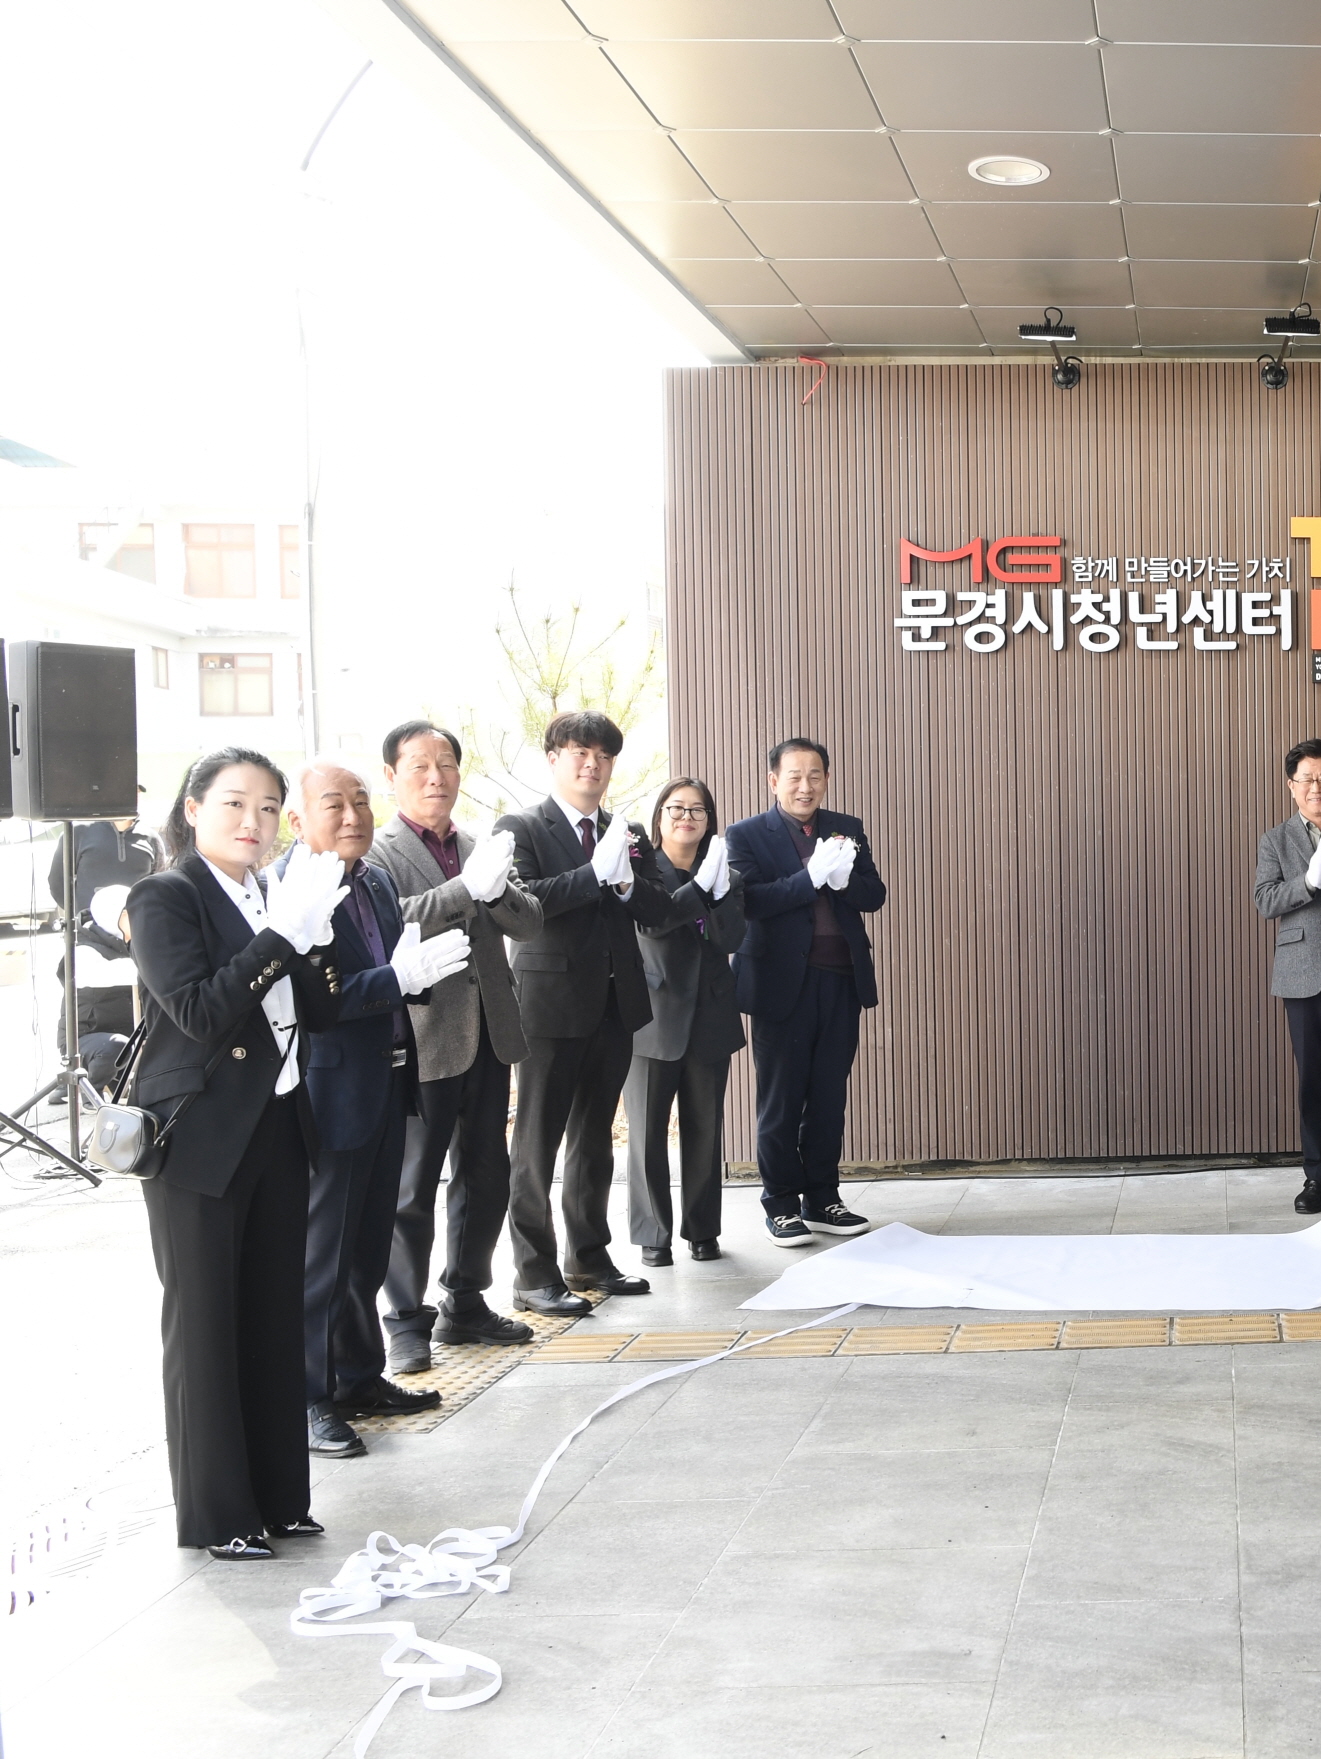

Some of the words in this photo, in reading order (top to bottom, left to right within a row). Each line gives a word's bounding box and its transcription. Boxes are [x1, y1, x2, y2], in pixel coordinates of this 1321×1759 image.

[900, 536, 1062, 584] MG
[1070, 556, 1119, 582] 함께
[1125, 556, 1240, 583] 만들어가는
[1245, 556, 1291, 583] 가치
[893, 588, 1293, 653] 문경시청년센터
